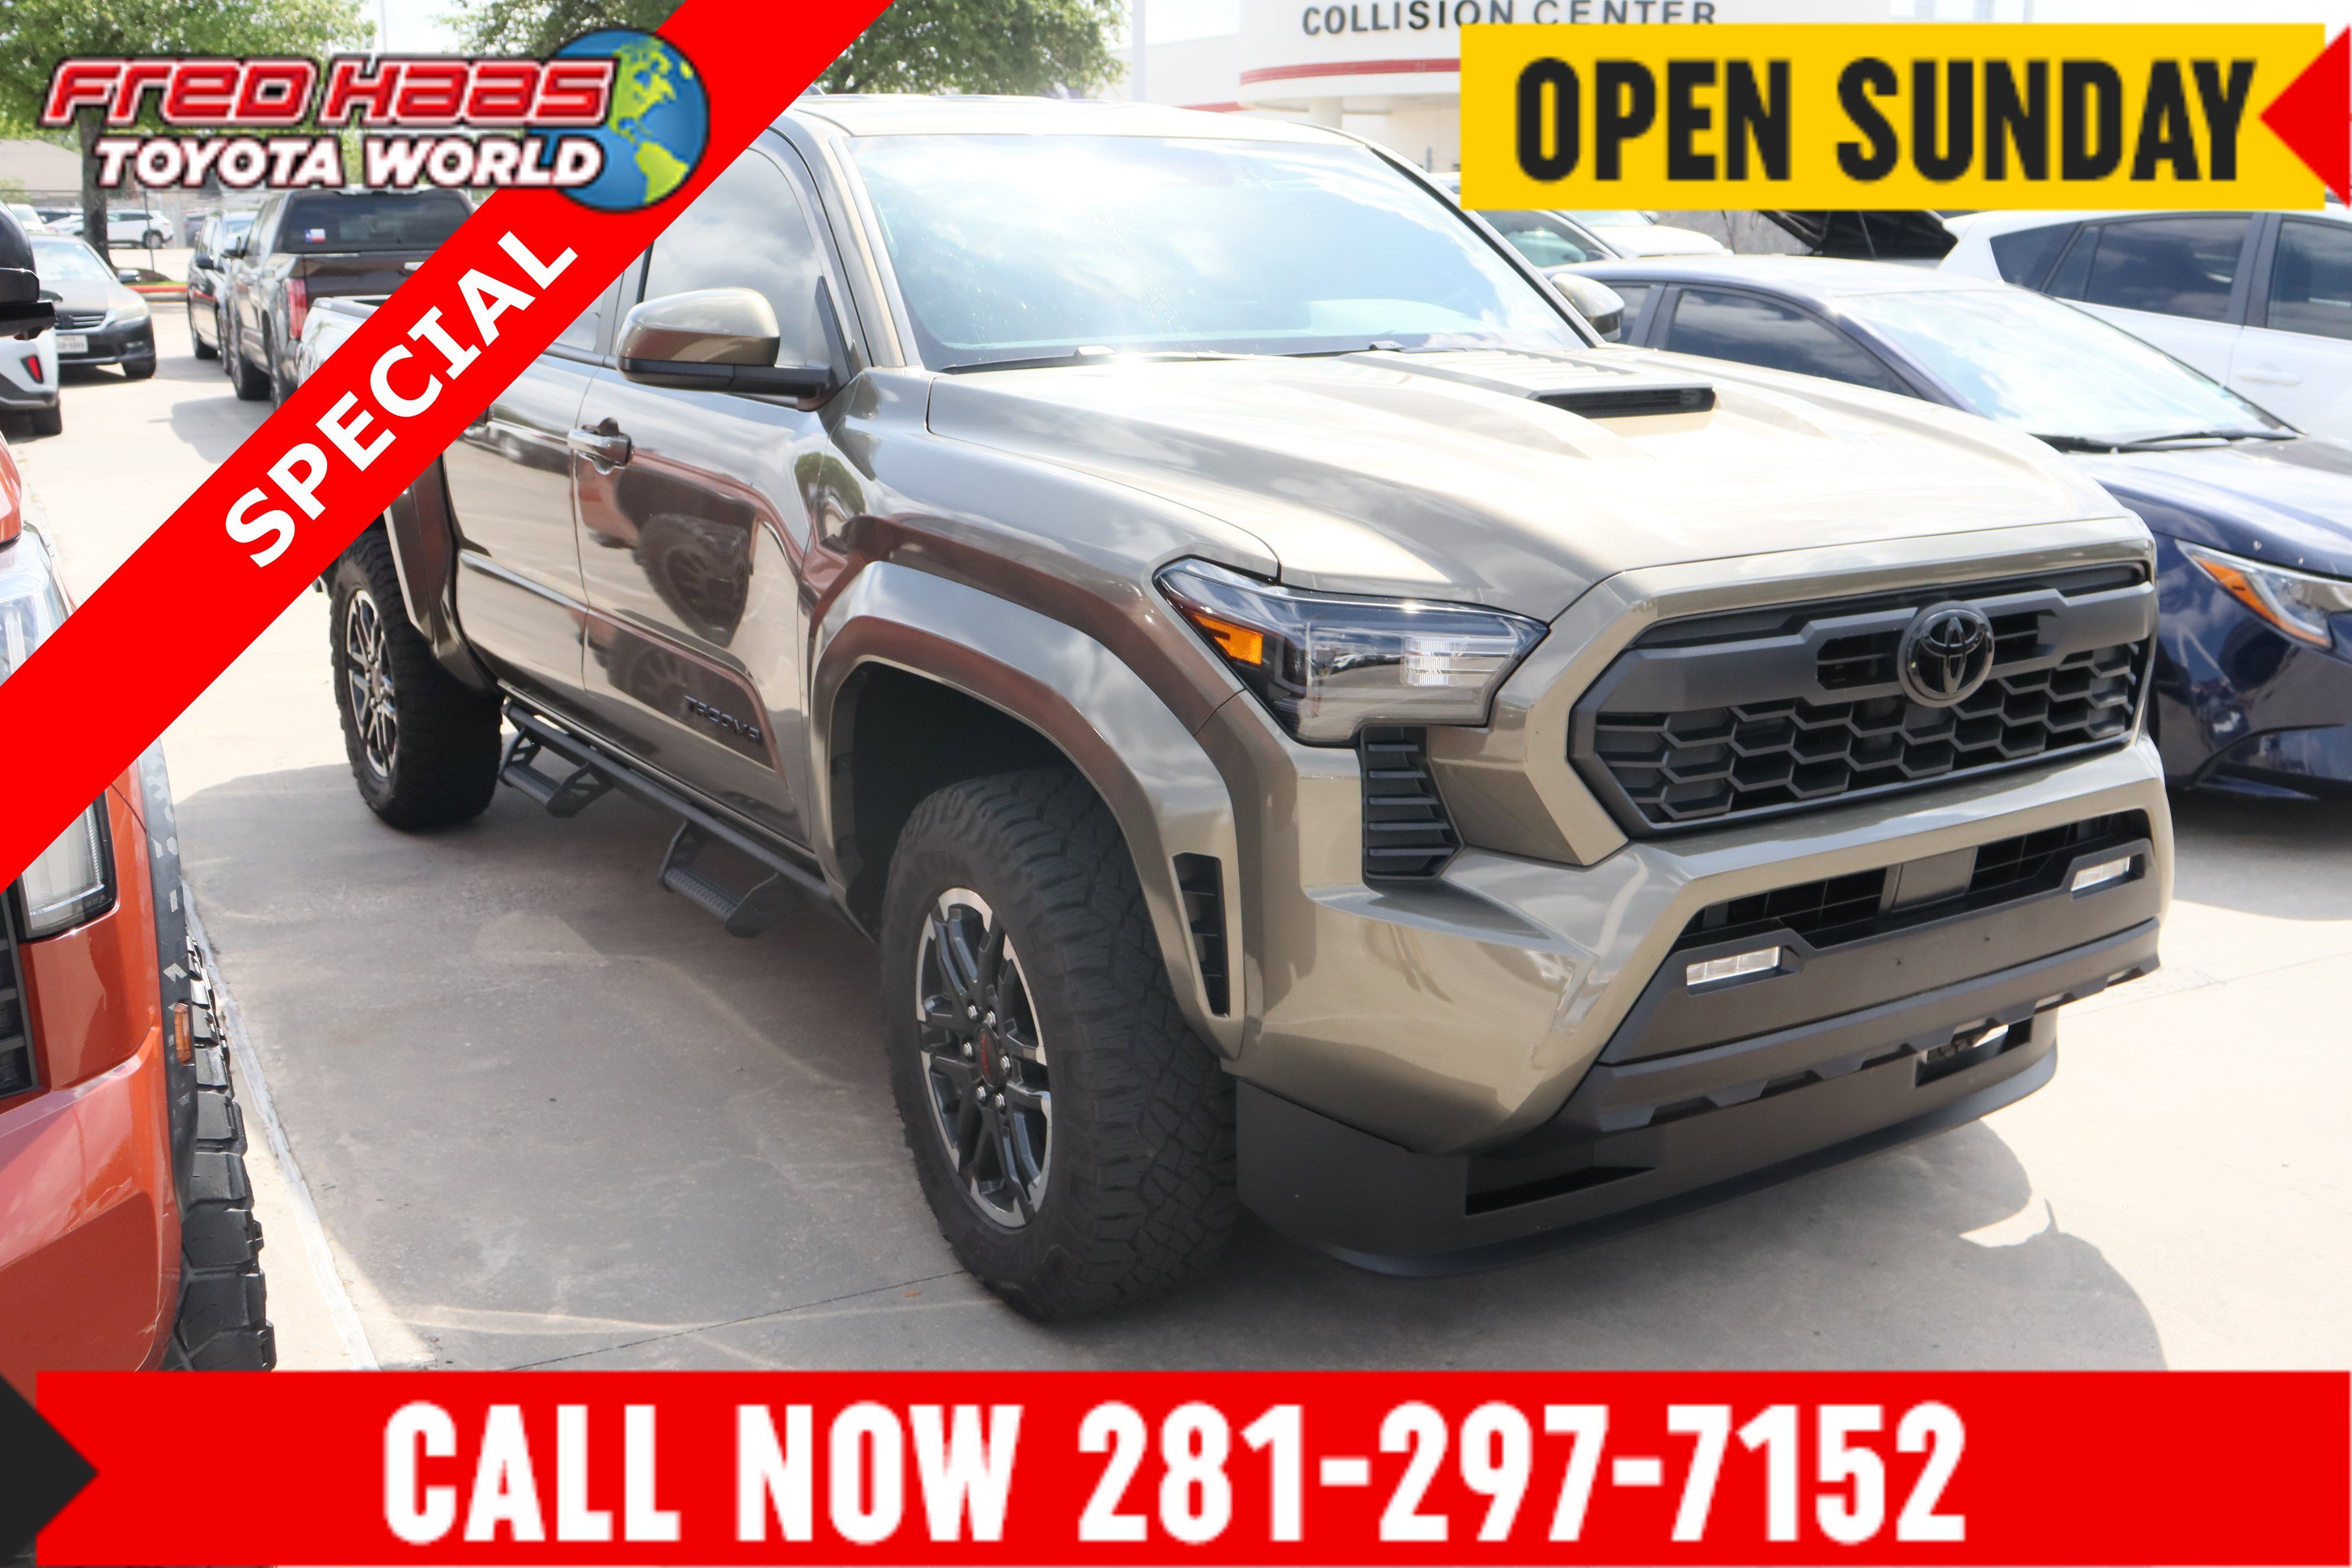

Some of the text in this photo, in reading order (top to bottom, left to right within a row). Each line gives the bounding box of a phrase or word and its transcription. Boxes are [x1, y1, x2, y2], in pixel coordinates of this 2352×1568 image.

[1302, 0, 1716, 35] COLLISION CENTER
[684, 695, 762, 744] TACOMA
